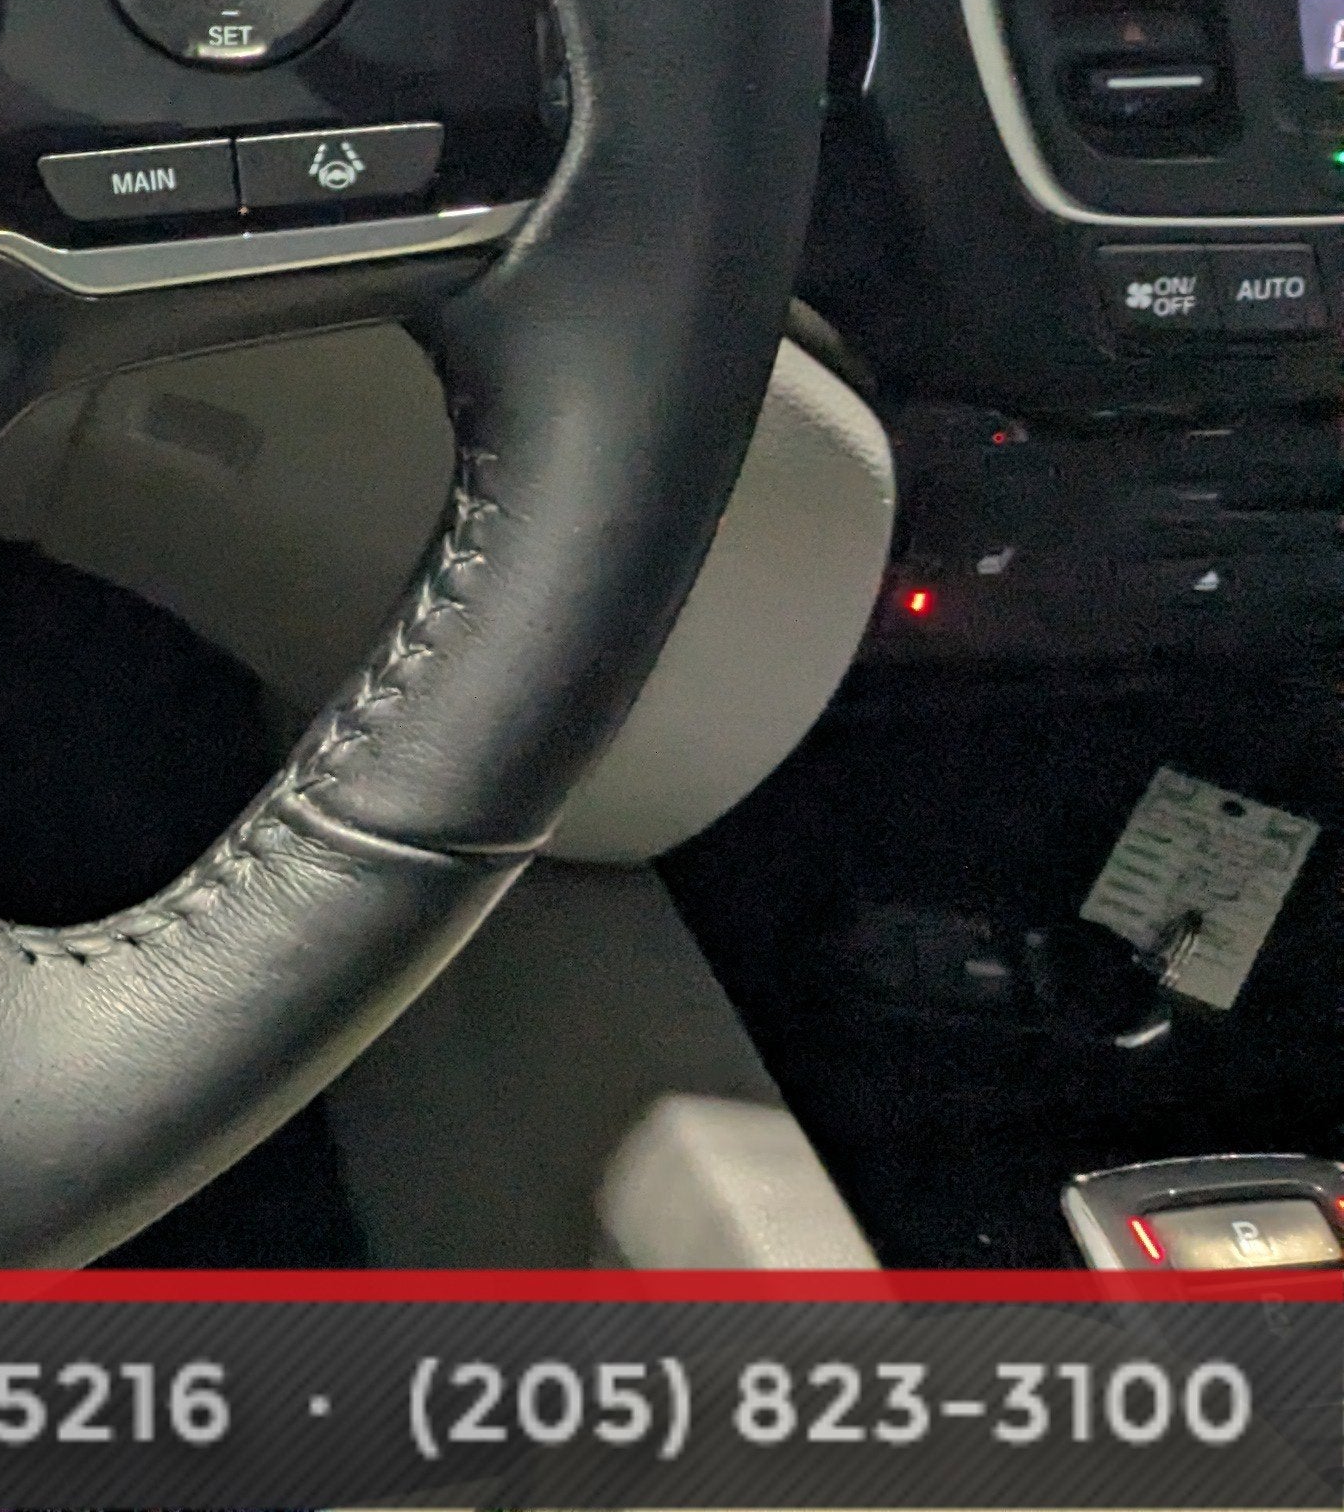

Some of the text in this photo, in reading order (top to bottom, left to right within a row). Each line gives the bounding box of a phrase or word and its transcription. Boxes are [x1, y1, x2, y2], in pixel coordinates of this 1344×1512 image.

[208, 24, 253, 47] SET
[111, 168, 177, 196] MAIN
[1236, 275, 1306, 302] AUTO
[1153, 295, 1196, 318] OFF
